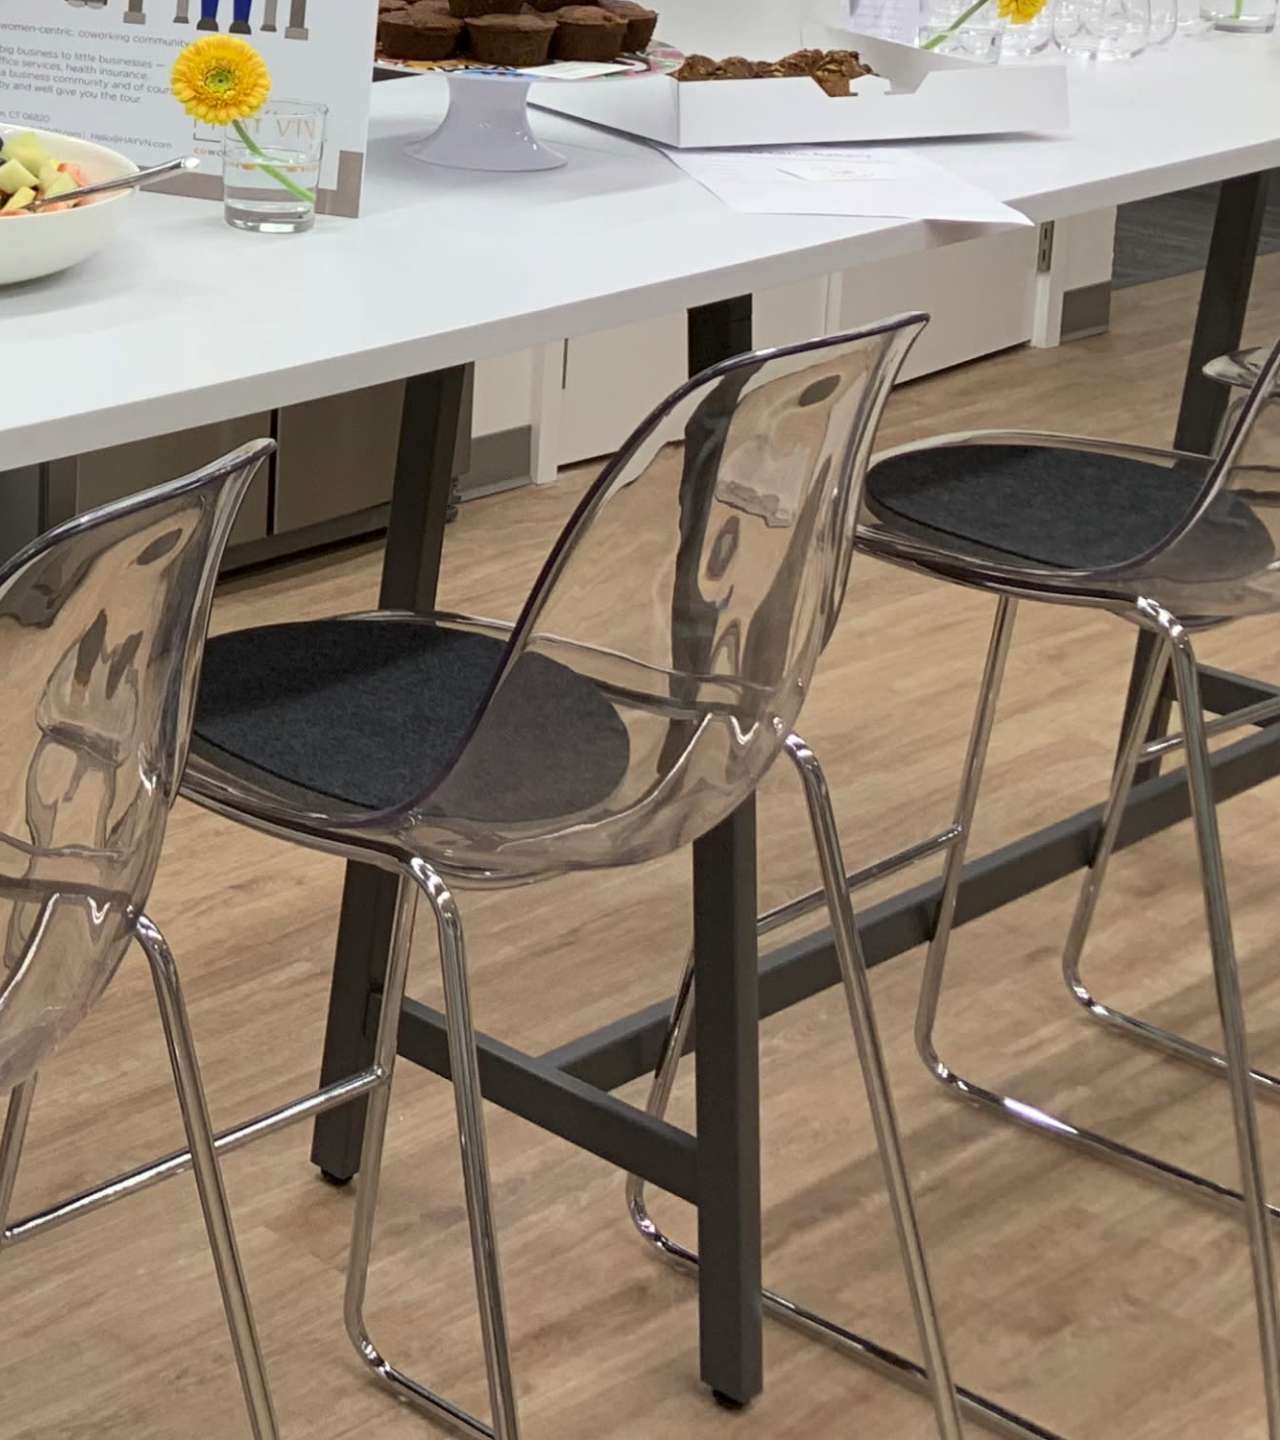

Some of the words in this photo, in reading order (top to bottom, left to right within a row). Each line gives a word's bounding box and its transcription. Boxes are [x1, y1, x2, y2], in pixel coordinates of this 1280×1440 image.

[78, 29, 130, 44] coworking
[16, 46, 59, 60] business
[61, 50, 72, 60] to
[98, 54, 153, 69] businesses
[65, 63, 97, 75] health
[8, 68, 51, 82] business
[52, 74, 109, 90] community
[111, 80, 131, 91] and
[133, 82, 144, 93] of
[12, 80, 32, 91] and
[55, 86, 77, 97] give
[79, 89, 98, 100] you
[100, 91, 117, 102] the
